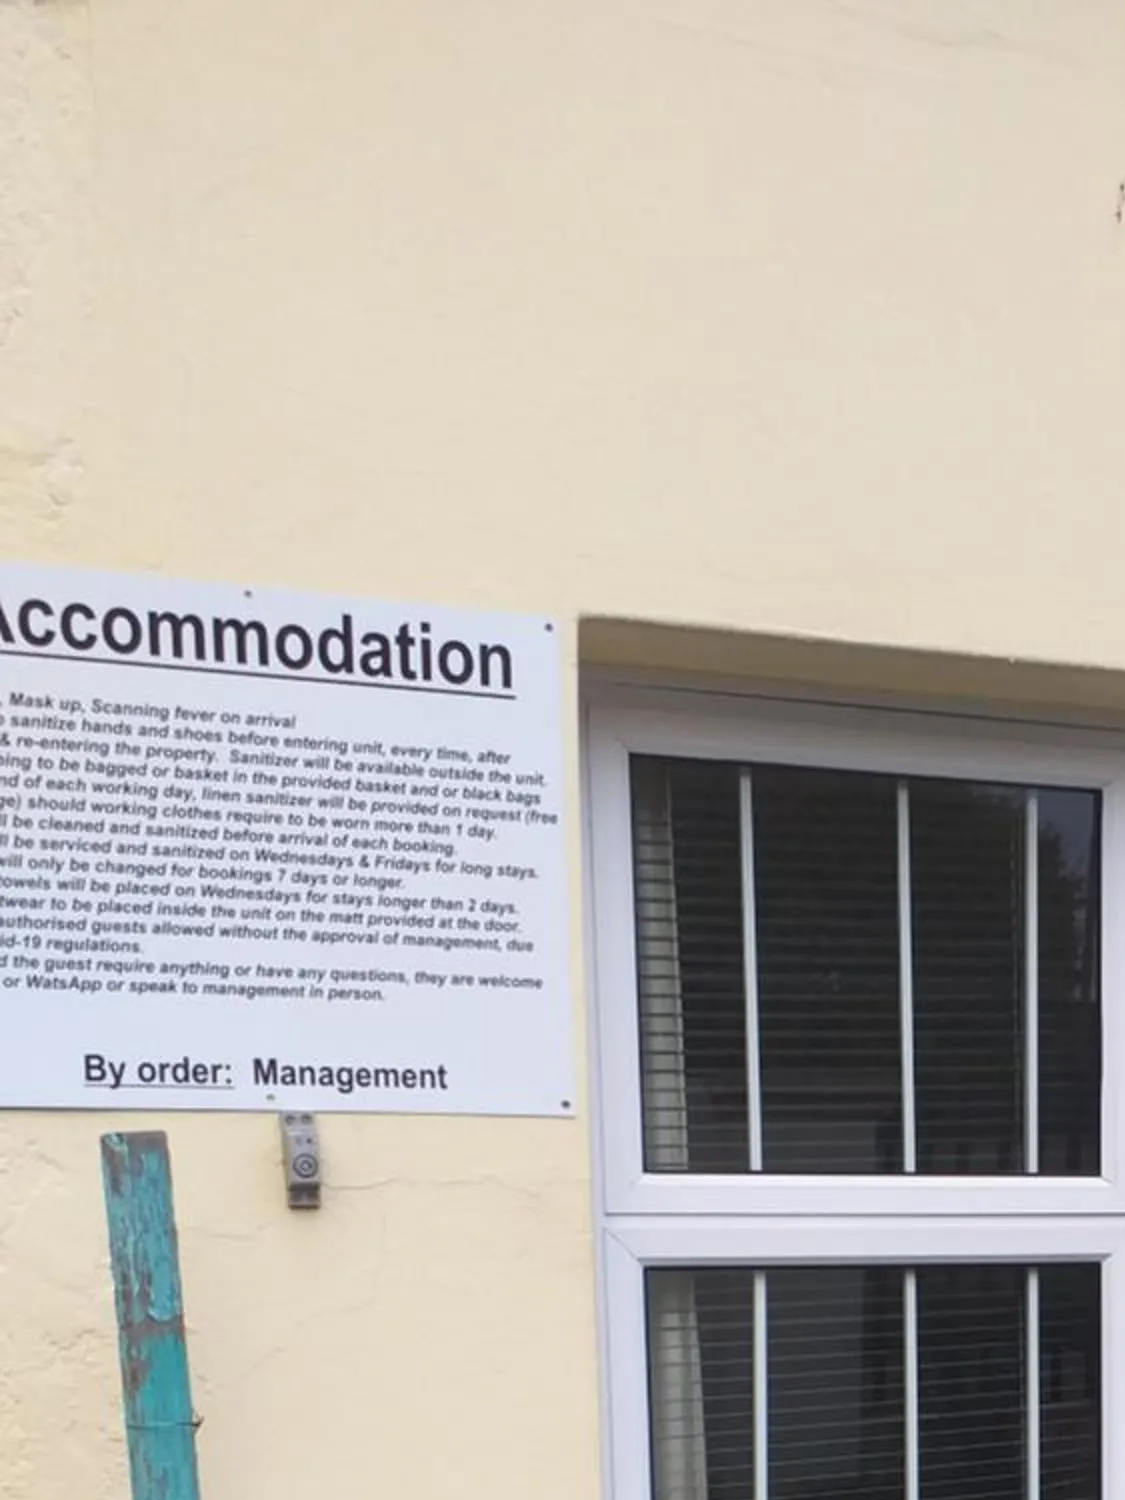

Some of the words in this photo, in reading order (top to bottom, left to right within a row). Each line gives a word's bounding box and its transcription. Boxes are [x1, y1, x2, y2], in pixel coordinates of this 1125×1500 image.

[0, 598, 513, 688] ccommodation
[9, 693, 54, 709] Mask
[91, 699, 170, 722] Scanning
[175, 706, 216, 723] fever
[220, 712, 241, 724] on
[245, 713, 296, 729] arrival
[10, 716, 76, 732] sanitize
[82, 719, 132, 736] hands
[138, 725, 169, 739] and
[174, 726, 222, 742] shoes
[228, 730, 279, 747] before
[284, 735, 348, 755] entering
[390, 744, 432, 762] every
[477, 749, 511, 765] after
[17, 735, 109, 757] re-entering
[115, 740, 141, 755] the
[229, 749, 298, 767] Sanitizer
[303, 755, 330, 770] will
[334, 757, 353, 771] be
[357, 760, 424, 777] available
[428, 765, 484, 781] outside
[488, 768, 511, 783] the
[23, 776, 42, 790] of
[46, 778, 86, 792] each
[92, 781, 158, 800] working
[202, 786, 240, 802] linen
[246, 791, 312, 807] sanitizer
[318, 795, 344, 809] will
[348, 796, 367, 811] be
[371, 800, 438, 816] provided
[442, 805, 461, 817] on
[466, 807, 521, 823] request
[37, 755, 53, 769] to
[60, 757, 80, 771] be
[85, 758, 147, 778] bagged
[152, 766, 170, 778] or
[174, 765, 228, 782] basket
[233, 769, 248, 783] in
[252, 770, 278, 785] the
[281, 774, 350, 790] provided
[355, 777, 406, 795] basket
[410, 783, 438, 797] and
[442, 786, 458, 798] or
[462, 785, 501, 801] black
[506, 788, 541, 807] bags
[13, 814, 34, 829] be
[38, 816, 104, 833] cleaned
[109, 821, 140, 835] and
[146, 824, 219, 840] sanitized
[223, 827, 274, 843] before
[278, 831, 328, 847] arrival
[332, 834, 349, 848] of
[352, 836, 388, 850] each
[28, 796, 86, 812] should
[91, 801, 157, 820] working
[162, 803, 222, 820] clothes
[227, 809, 283, 825] require
[288, 811, 303, 825] to
[308, 812, 327, 827] be
[332, 816, 370, 830] worn
[374, 819, 413, 833] more
[418, 819, 450, 835] than
[14, 834, 34, 849] be
[40, 838, 112, 853] serviced
[117, 841, 148, 855] and
[152, 844, 225, 860] sanitized
[230, 849, 249, 861] on
[255, 848, 354, 870] Wednesdays
[359, 854, 370, 868] &
[375, 855, 430, 875] Fridays
[435, 859, 456, 874] for
[460, 860, 493, 879] long
[28, 856, 65, 874] only
[69, 857, 90, 872] be
[95, 859, 166, 879] changed
[171, 863, 194, 878] for
[199, 865, 272, 885] bookings
[291, 870, 328, 888] days
[332, 874, 348, 886] or
[57, 877, 86, 892] will
[90, 878, 110, 893] be
[116, 880, 170, 897] placed
[175, 885, 196, 897] on
[201, 884, 301, 905] Wednesdays
[306, 889, 328, 904] for
[333, 891, 373, 909] stays
[377, 893, 426, 911] longer
[430, 895, 464, 911] than
[51, 896, 66, 911] to
[72, 897, 92, 912] be
[97, 899, 152, 916] placed
[157, 901, 206, 917] inside
[211, 904, 236, 918] the
[241, 906, 271, 920] unit
[275, 909, 296, 921] on
[301, 908, 325, 923] the
[367, 913, 434, 929] provided
[438, 915, 452, 929] at
[457, 916, 480, 930] the
[91, 920, 147, 935] guests
[152, 921, 215, 937] allowed
[219, 924, 278, 940] without
[283, 926, 306, 941] the
[312, 930, 379, 946] approval
[383, 932, 399, 946] of
[506, 937, 534, 952] due
[3, 976, 20, 988] or
[106, 980, 124, 992] or
[129, 979, 177, 996] speak
[182, 980, 198, 994] to
[203, 983, 304, 999] management
[309, 984, 323, 998] in
[13, 954, 39, 969] the
[44, 957, 92, 973] guest
[96, 959, 155, 976] require
[160, 961, 230, 980] anything
[234, 965, 251, 977] or
[256, 964, 293, 979] have
[298, 968, 326, 984] any
[414, 970, 447, 988] they
[451, 974, 474, 986] are
[478, 973, 543, 989] welcome
[84, 1053, 126, 1089] By
[137, 1057, 233, 1084] order:
[253, 1058, 449, 1093] Management
